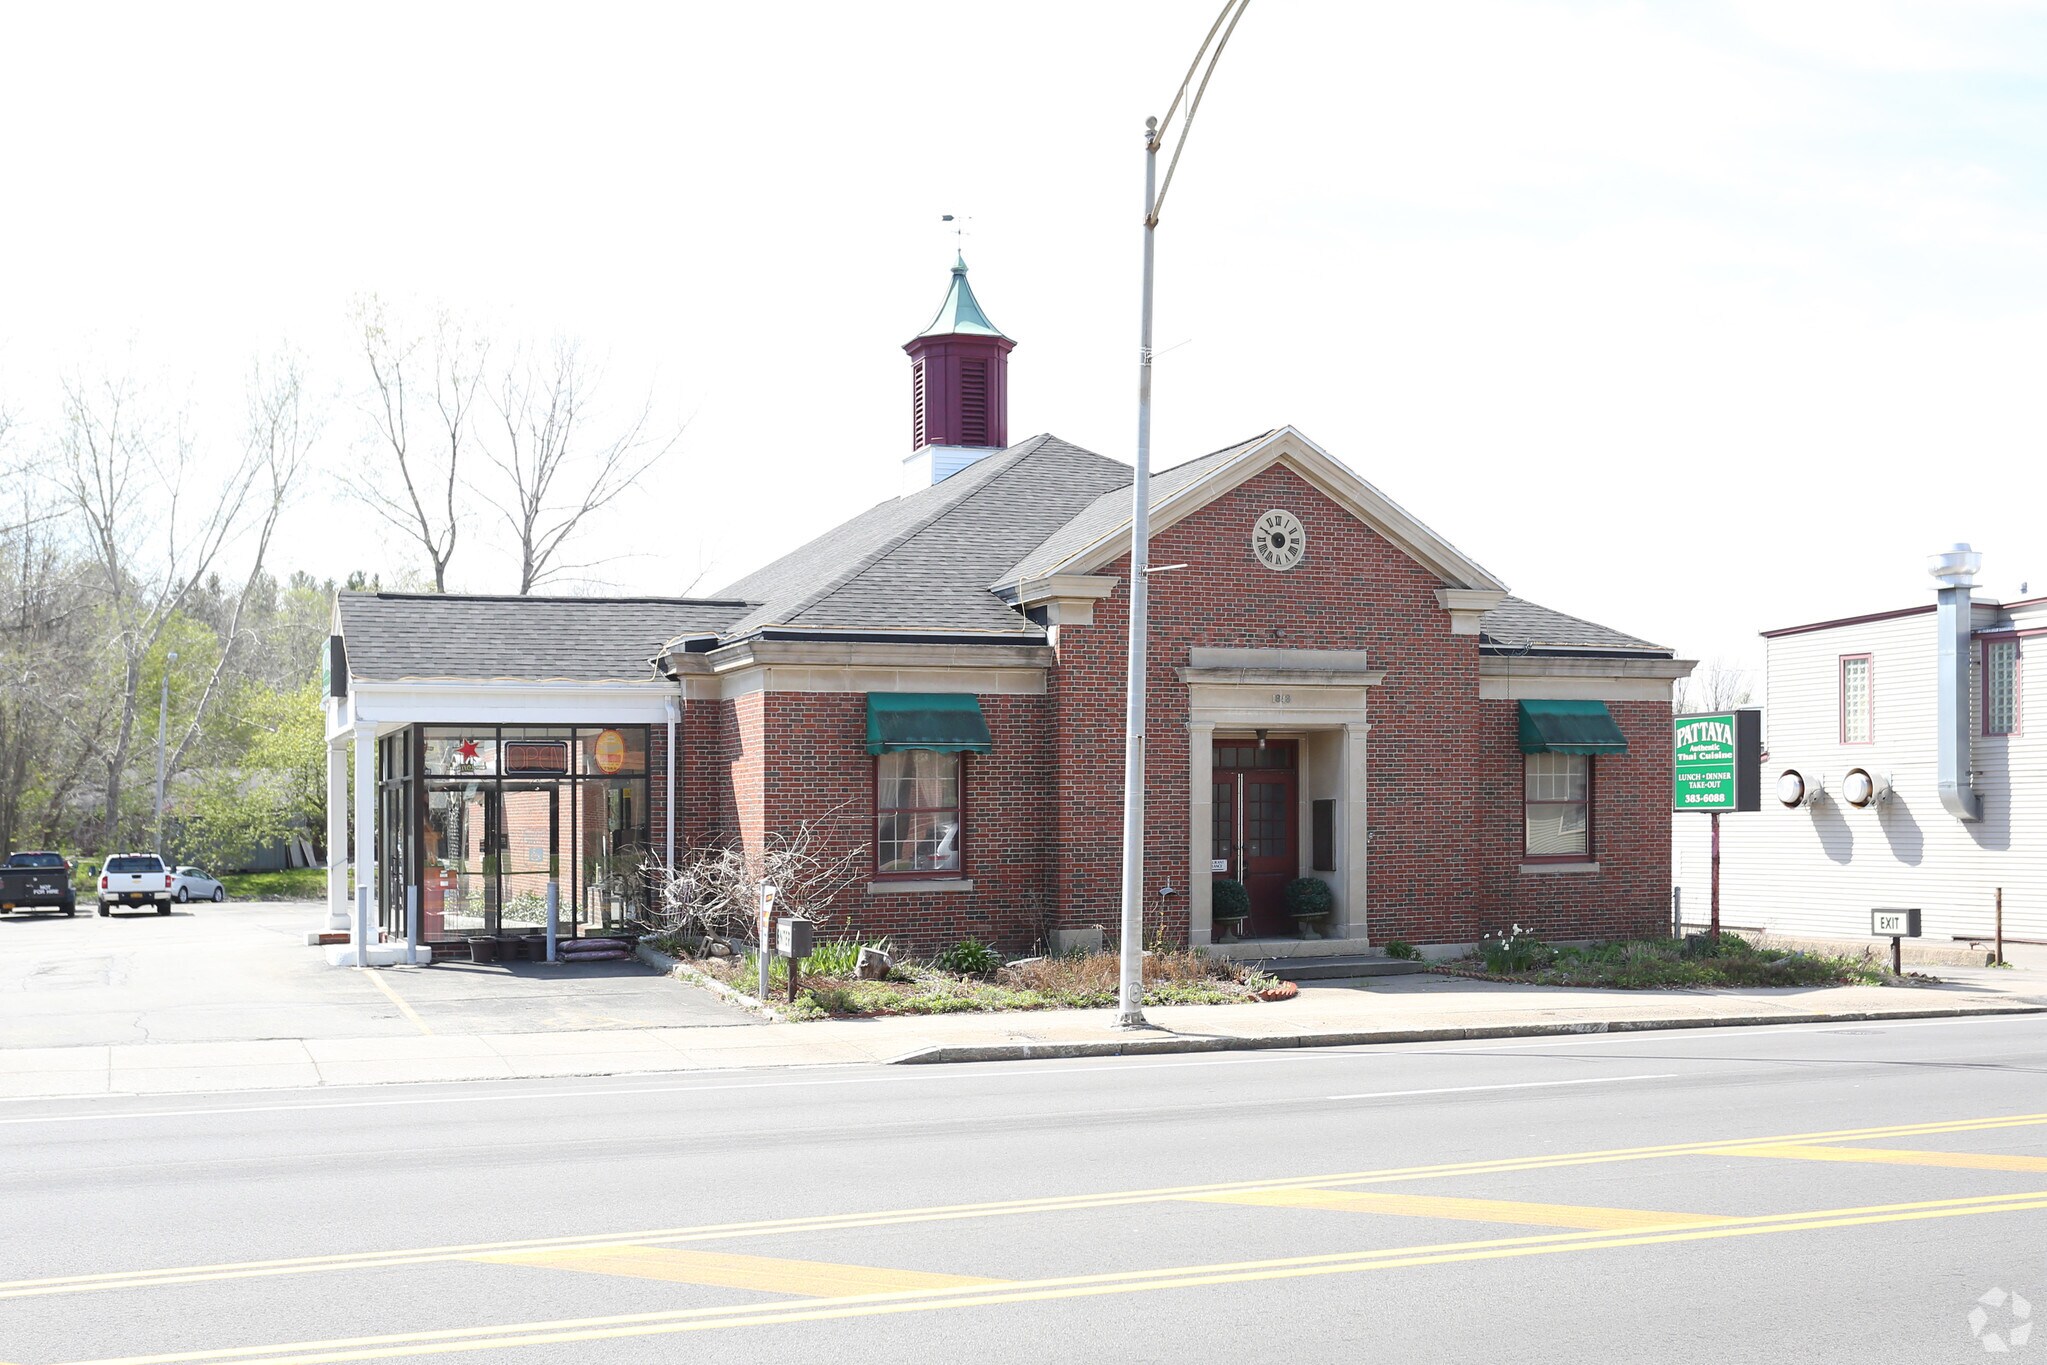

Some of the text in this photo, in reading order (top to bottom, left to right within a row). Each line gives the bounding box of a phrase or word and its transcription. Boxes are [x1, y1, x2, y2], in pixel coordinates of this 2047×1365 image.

[1677, 722, 1733, 748] PATTAYA
[1690, 744, 1720, 752] Authentic
[510, 746, 563, 770] OPEN
[1699, 752, 1732, 760] Cuisine
[1678, 772, 1731, 781] LUNCH DINNER
[1685, 794, 1726, 803] 383-6088
[1880, 917, 1899, 929] EXIT
